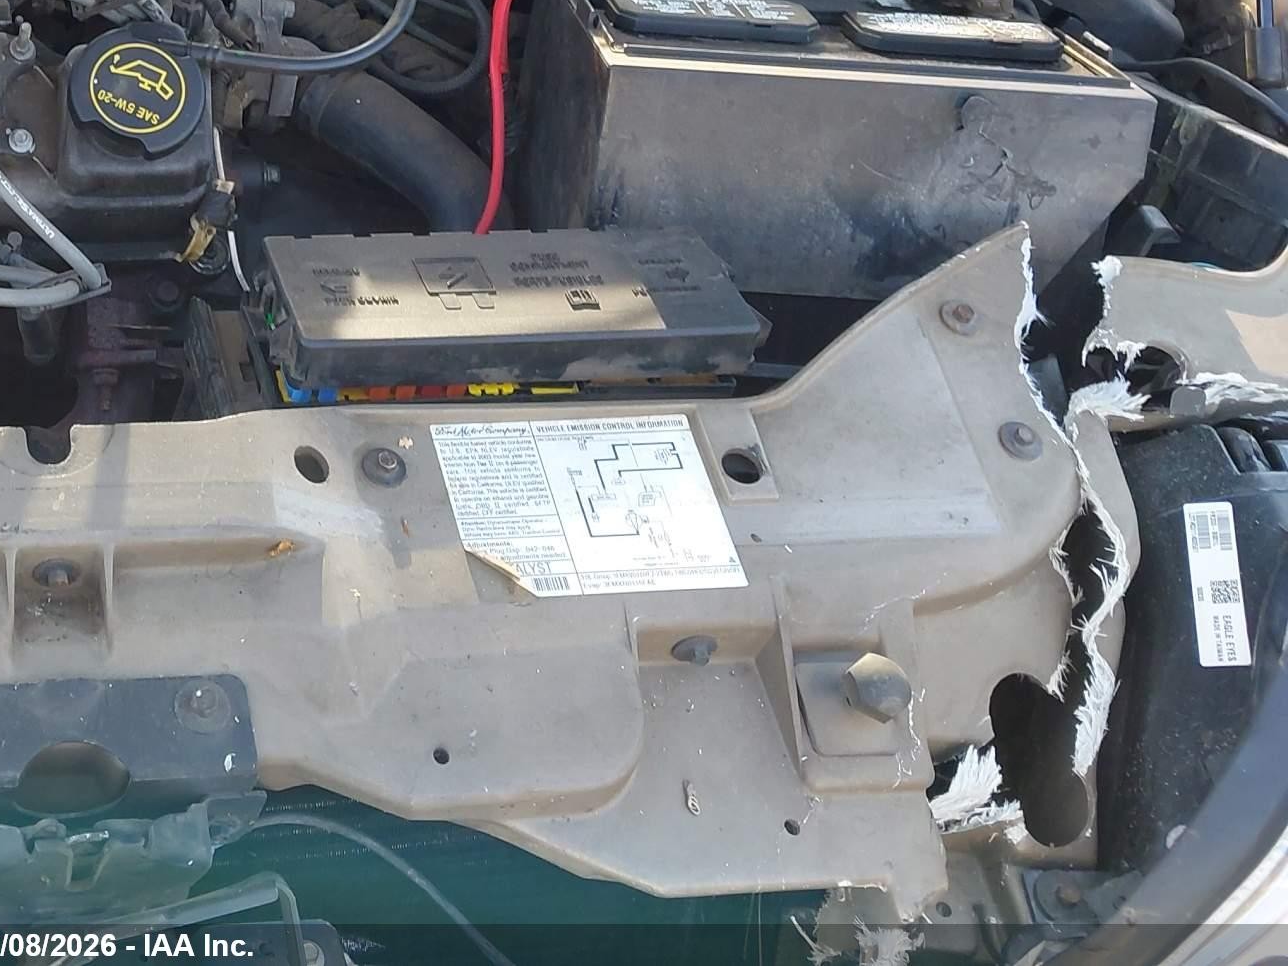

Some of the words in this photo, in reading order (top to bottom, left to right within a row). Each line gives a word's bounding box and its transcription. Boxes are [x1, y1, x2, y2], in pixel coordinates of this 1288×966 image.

[97, 89, 136, 114] 5W-20
[136, 107, 160, 125] SAE
[1223, 615, 1234, 639] EAGLE
[1226, 641, 1237, 662] EYES
